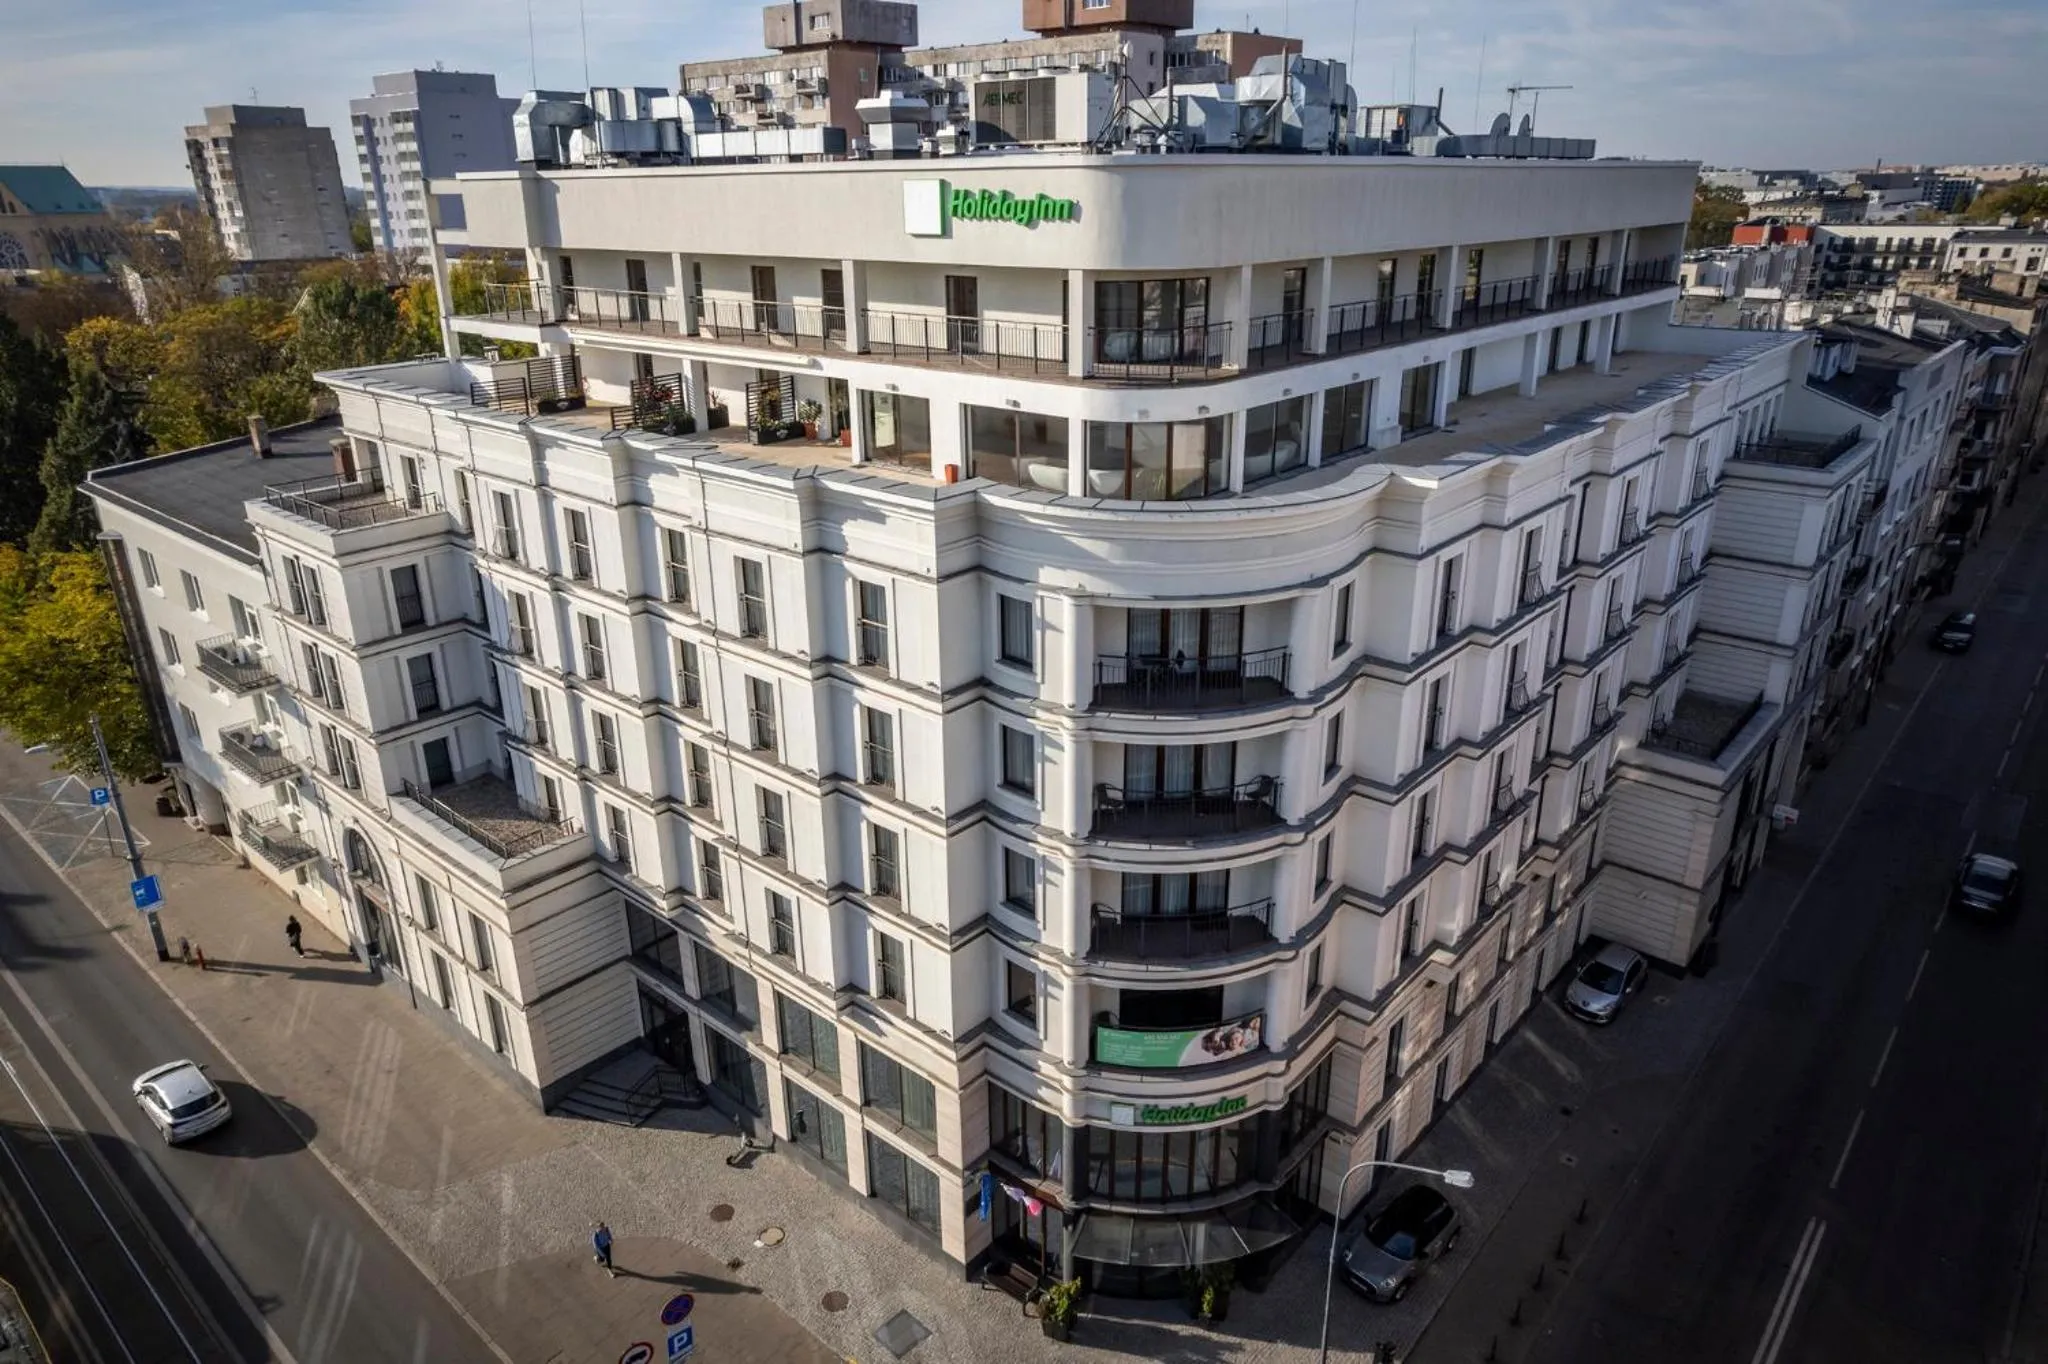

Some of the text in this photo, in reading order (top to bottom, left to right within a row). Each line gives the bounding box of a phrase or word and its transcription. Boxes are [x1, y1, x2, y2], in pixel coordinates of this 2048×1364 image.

[951, 188, 1074, 226] Holiday Inn
[94, 789, 105, 800] P
[673, 1331, 688, 1353] P
